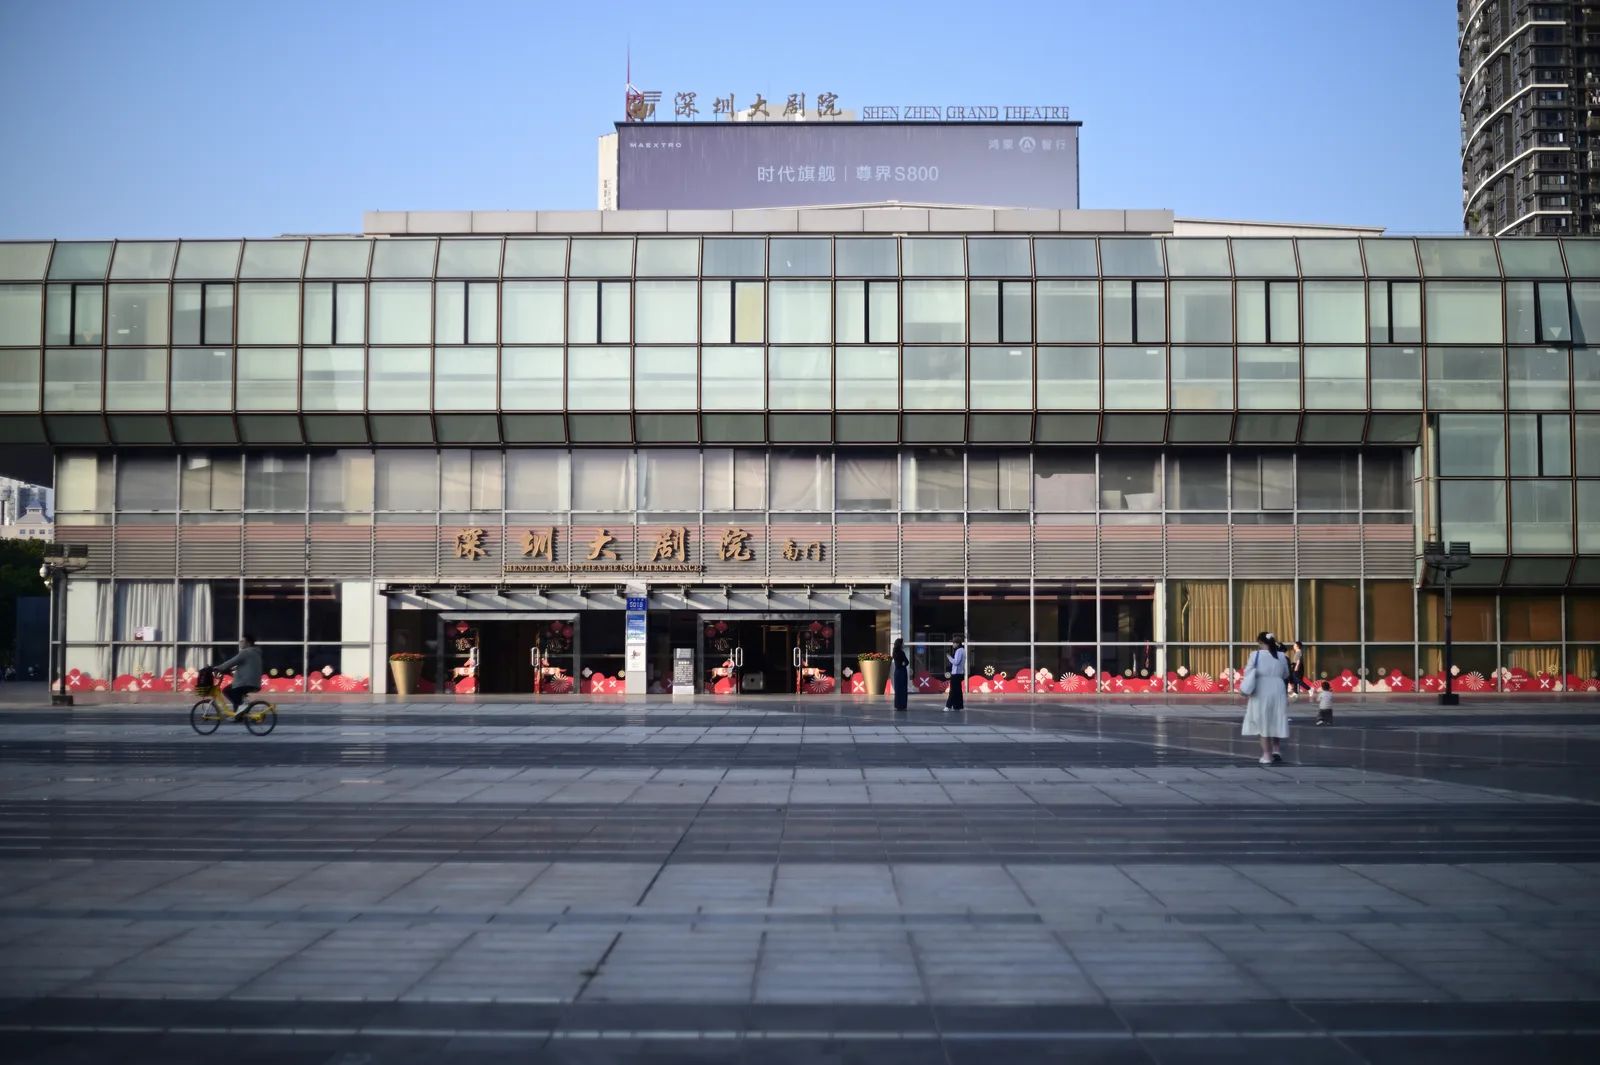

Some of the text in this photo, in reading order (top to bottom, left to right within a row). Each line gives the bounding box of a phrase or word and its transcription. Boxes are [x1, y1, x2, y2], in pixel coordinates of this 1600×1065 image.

[674, 91, 842, 118] 深圳大剧院
[863, 106, 1070, 119] SHEN ZHEN GRAND THEATRE
[757, 165, 939, 182] 时代旗舰 尊界S800
[456, 526, 751, 562] 深圳大剧院
[503, 564, 702, 572] SHENZHEN GRAND THEATRE (SOUTH ENTRANCE)
